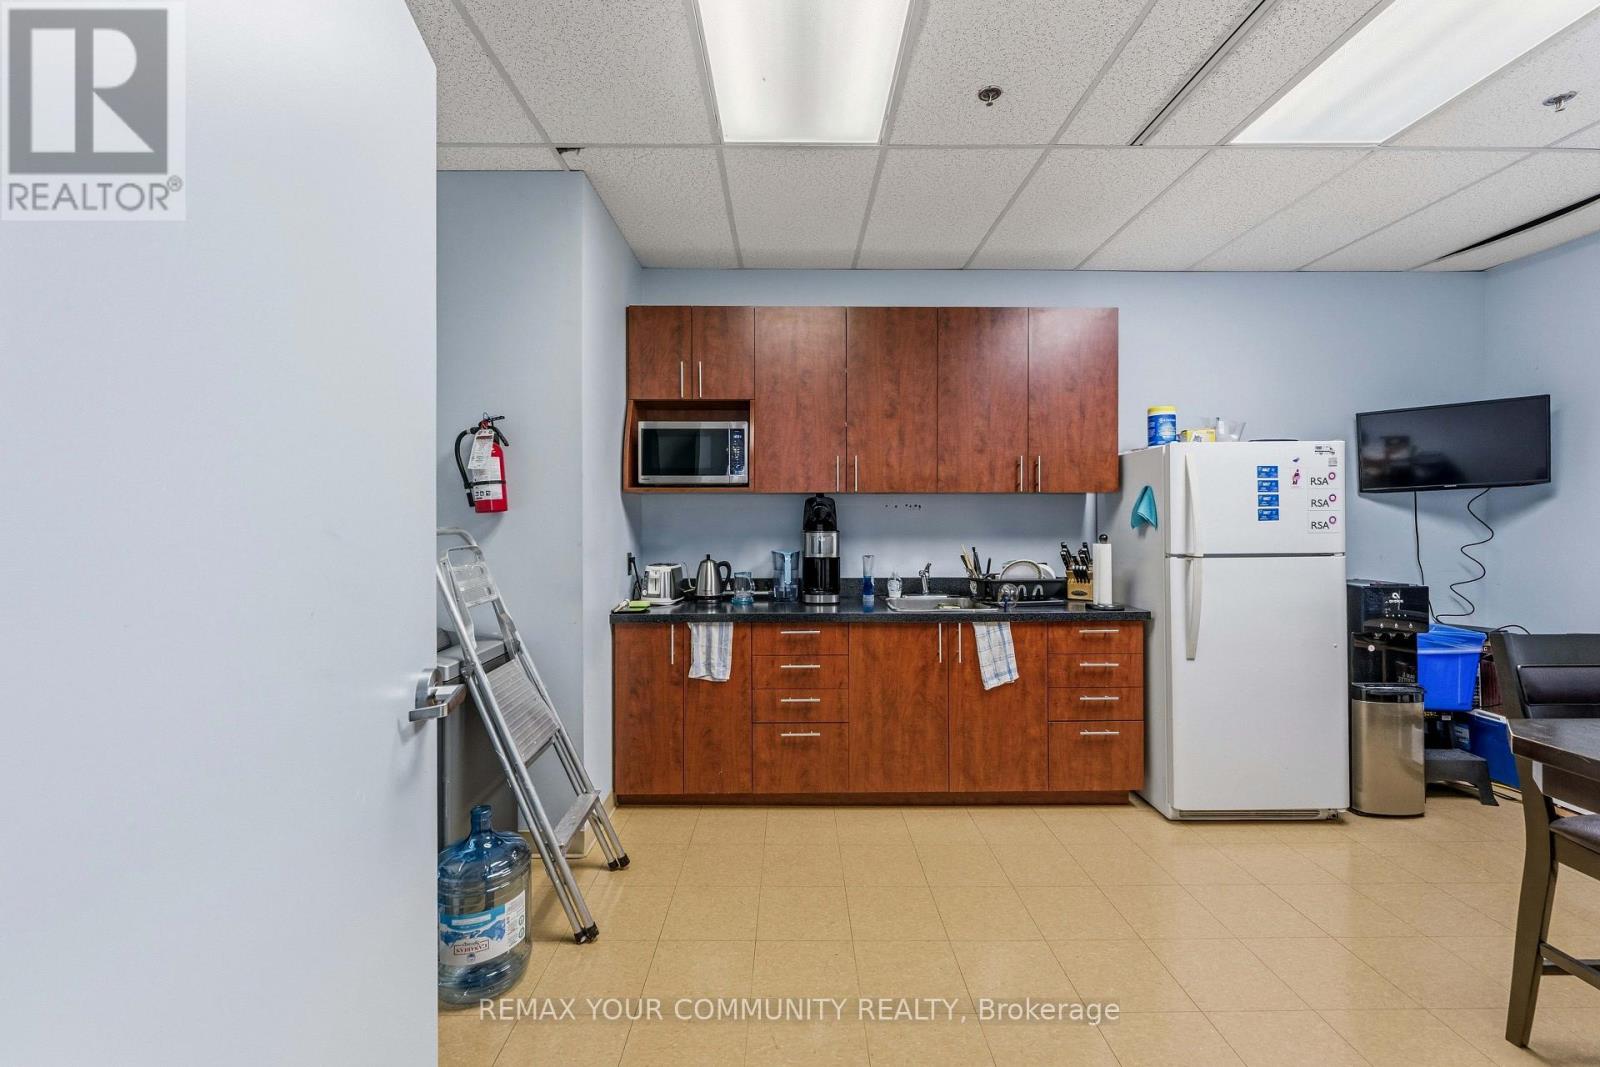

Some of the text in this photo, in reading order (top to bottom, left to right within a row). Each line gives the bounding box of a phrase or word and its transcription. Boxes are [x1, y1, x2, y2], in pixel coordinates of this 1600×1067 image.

[1310, 477, 1329, 486] RSA
[1311, 499, 1330, 508] RSA
[1311, 521, 1330, 530] RSA
